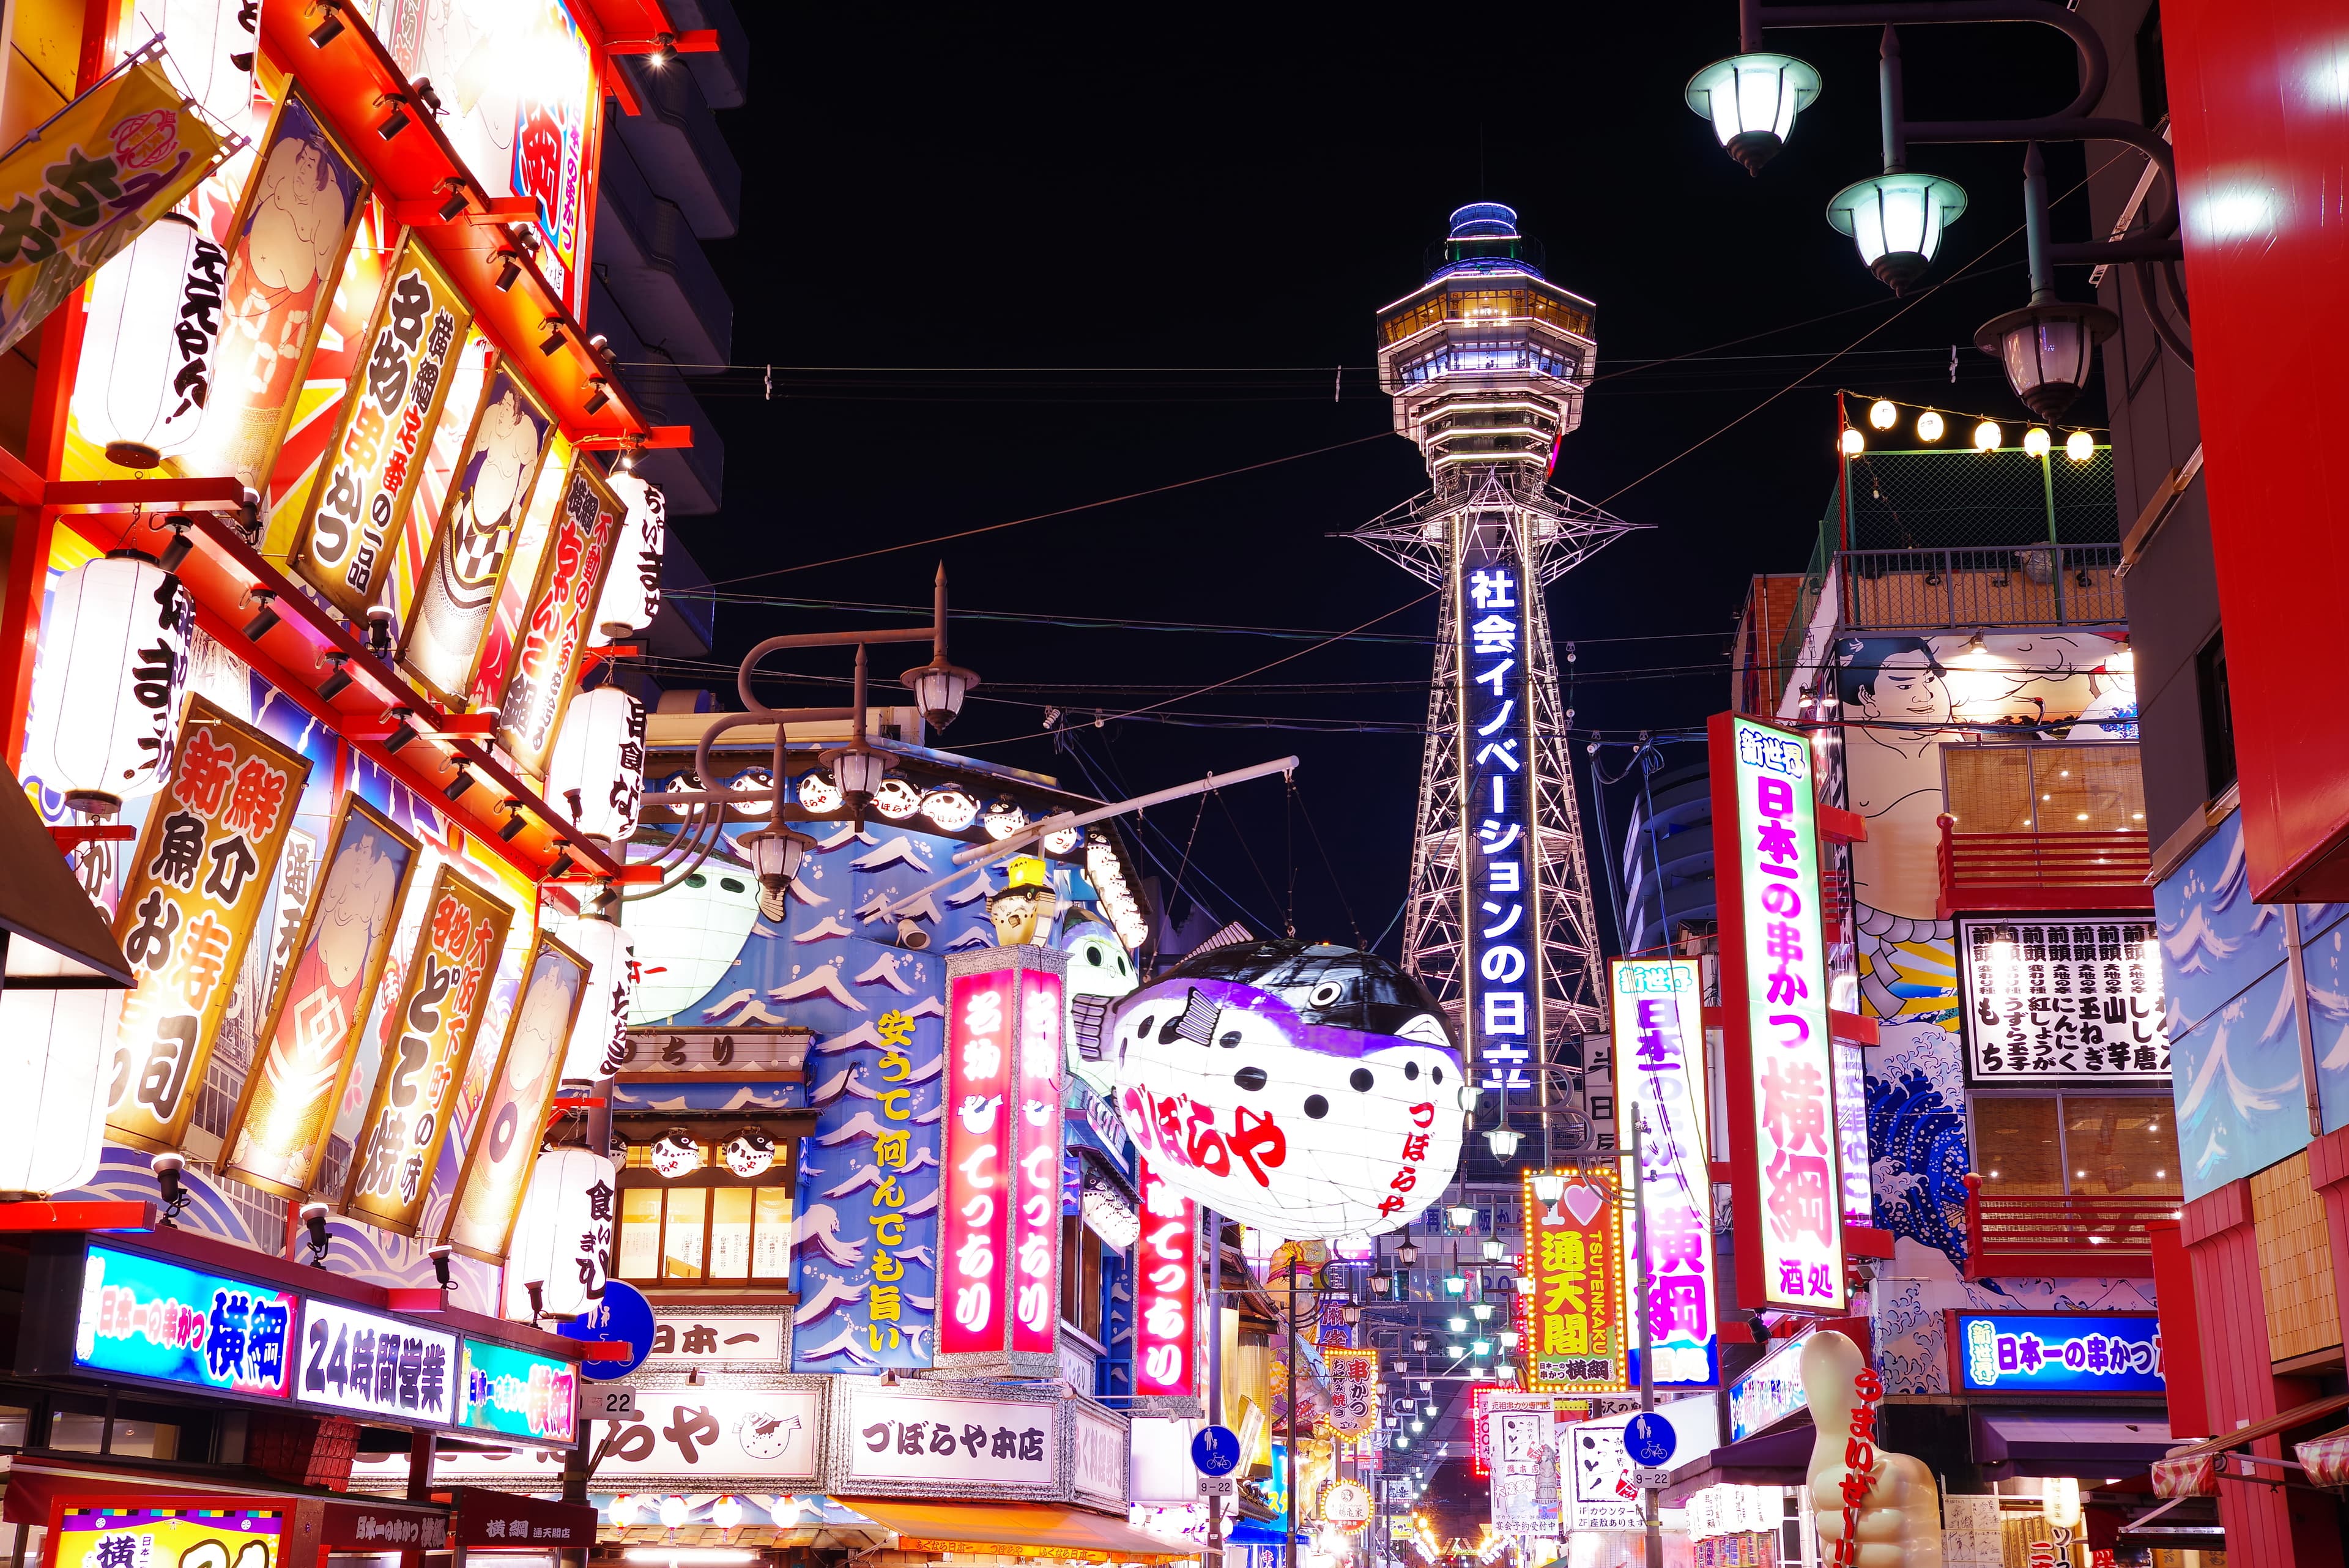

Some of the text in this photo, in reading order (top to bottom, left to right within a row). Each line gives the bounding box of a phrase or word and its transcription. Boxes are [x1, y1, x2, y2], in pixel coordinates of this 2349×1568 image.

[316, 272, 430, 563] 名物串かつ
[177, 736, 284, 839] 新鮮
[1741, 729, 1805, 777] 新世界
[1471, 570, 1530, 1088] 社会イノベーションの日立
[1757, 777, 1809, 1048] 日本一の串かつ
[2022, 927, 2046, 962] 前頭
[2123, 926, 2147, 961] 前頭
[1619, 967, 1691, 994] 新世界
[2047, 926, 2077, 1071] 前頭 大地の幸 にんにく
[2072, 926, 2106, 1070] 前頭 大地の幸 玉ねぎ
[2097, 926, 2131, 1071] 前頭 大地の幸 山芋
[1978, 998, 2003, 1071] もち
[2004, 998, 2031, 1070] うずら玉子
[2028, 997, 2056, 1070] 紅しょうが
[2130, 997, 2157, 1071] しし唐
[956, 991, 1001, 1332] 名物 てっちり
[1019, 991, 1057, 1332] 名物 てっちり
[1124, 1083, 1285, 1187] づぼらや
[1379, 1099, 1438, 1217] づぼらや
[1761, 1057, 1831, 1248] 横綱
[869, 1009, 916, 1351] 安うて何んでも旨い
[1542, 1231, 1588, 1355] 通天閣
[1589, 1230, 1608, 1354] TSUTENKAKU
[1631, 1205, 1705, 1344] 横綱
[1781, 1258, 1833, 1296] 酒処
[100, 1291, 204, 1349] 日本一の串かつ
[206, 1290, 288, 1384] 横綱
[1970, 1325, 1995, 1383] 新世界
[1997, 1336, 2153, 1372] 日本一の串かつ
[306, 1318, 445, 1413] 24時間営業
[1332, 1359, 1346, 1417] お好み焼き
[1348, 1359, 1368, 1416] 串かつ
[1540, 1371, 1566, 1380] 串かつ
[1566, 1361, 1609, 1381] 横綱
[863, 1420, 1044, 1462] づぼらや本店
[1493, 1402, 1551, 1410] 元祖串カツ専門店
[355, 1515, 446, 1548] 日本一の串かつ 横綱
[486, 1519, 571, 1539] 横綱 通天閣店
[916, 1539, 974, 1553] ふぐなら日本一
[1040, 1547, 1097, 1560] ふぐなら日本一
[1496, 1521, 1556, 1531] 宴会予約受付中
[1578, 1518, 1587, 1527] 2F
